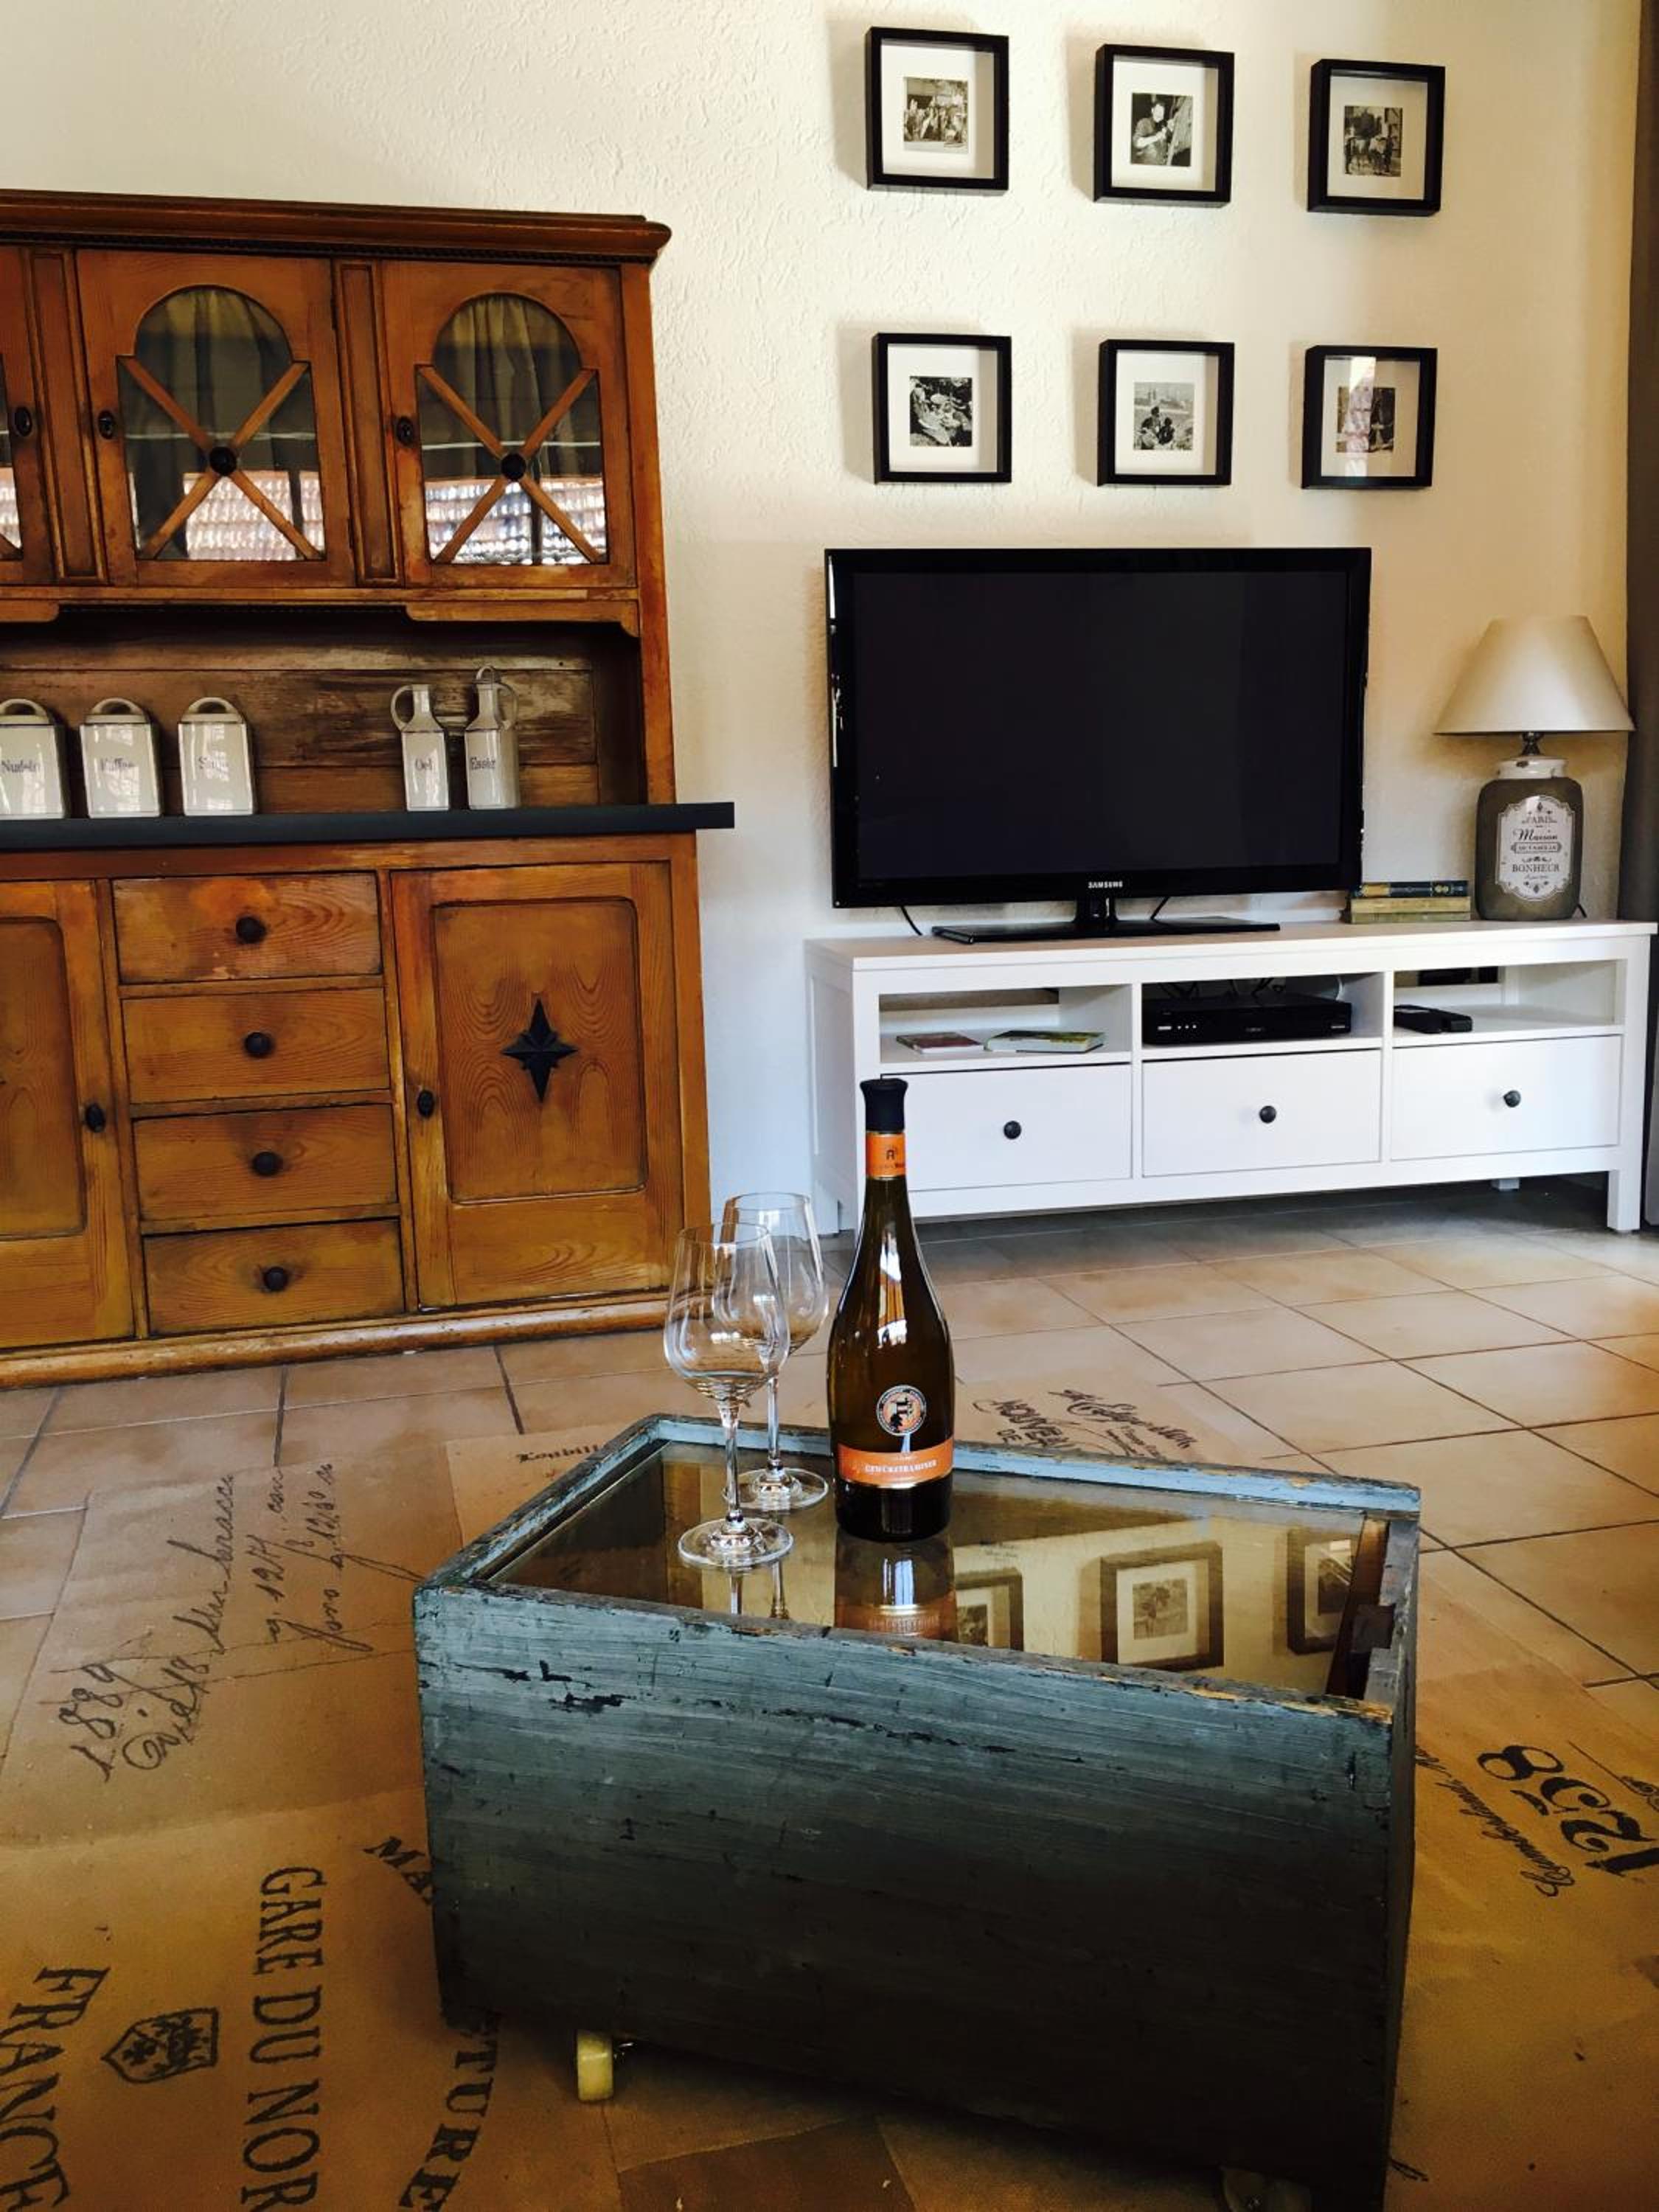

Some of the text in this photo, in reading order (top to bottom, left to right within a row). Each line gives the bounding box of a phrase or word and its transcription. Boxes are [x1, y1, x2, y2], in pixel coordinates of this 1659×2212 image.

[1088, 880, 1123, 888] SAMSUNG
[1512, 863, 1560, 872] BONHEUR
[252, 1865, 327, 1976] GARE
[248, 1985, 323, 2065] DU
